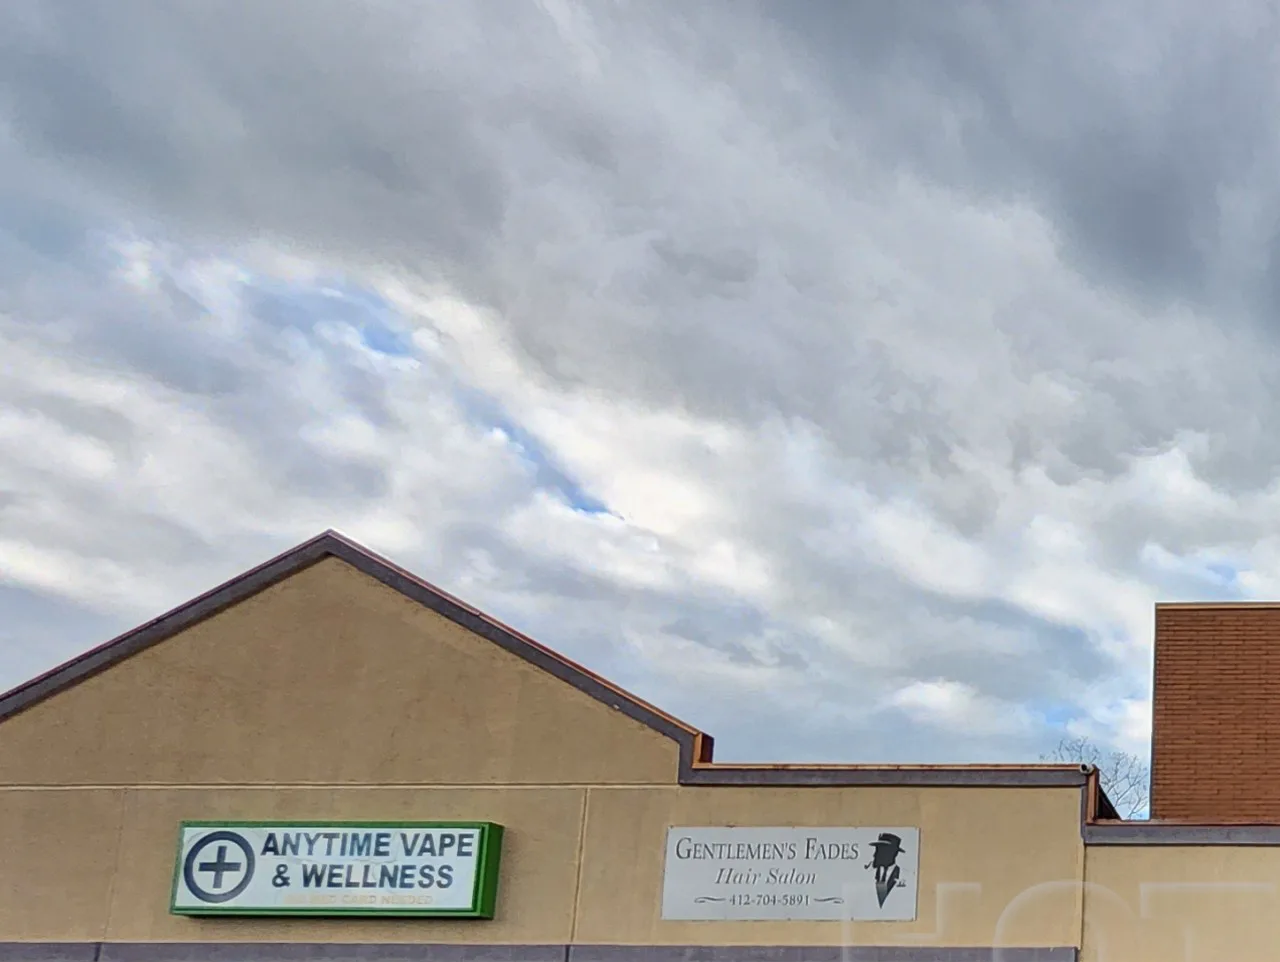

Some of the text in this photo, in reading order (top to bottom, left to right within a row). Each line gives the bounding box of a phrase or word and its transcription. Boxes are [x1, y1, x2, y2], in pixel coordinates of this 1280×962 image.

[260, 832, 474, 857] ANYTIME VAPE
[805, 838, 859, 860] FADES
[271, 864, 454, 889] & WELLNESS
[715, 868, 816, 885] Hair Salon
[729, 895, 810, 906] 412-704-5891
